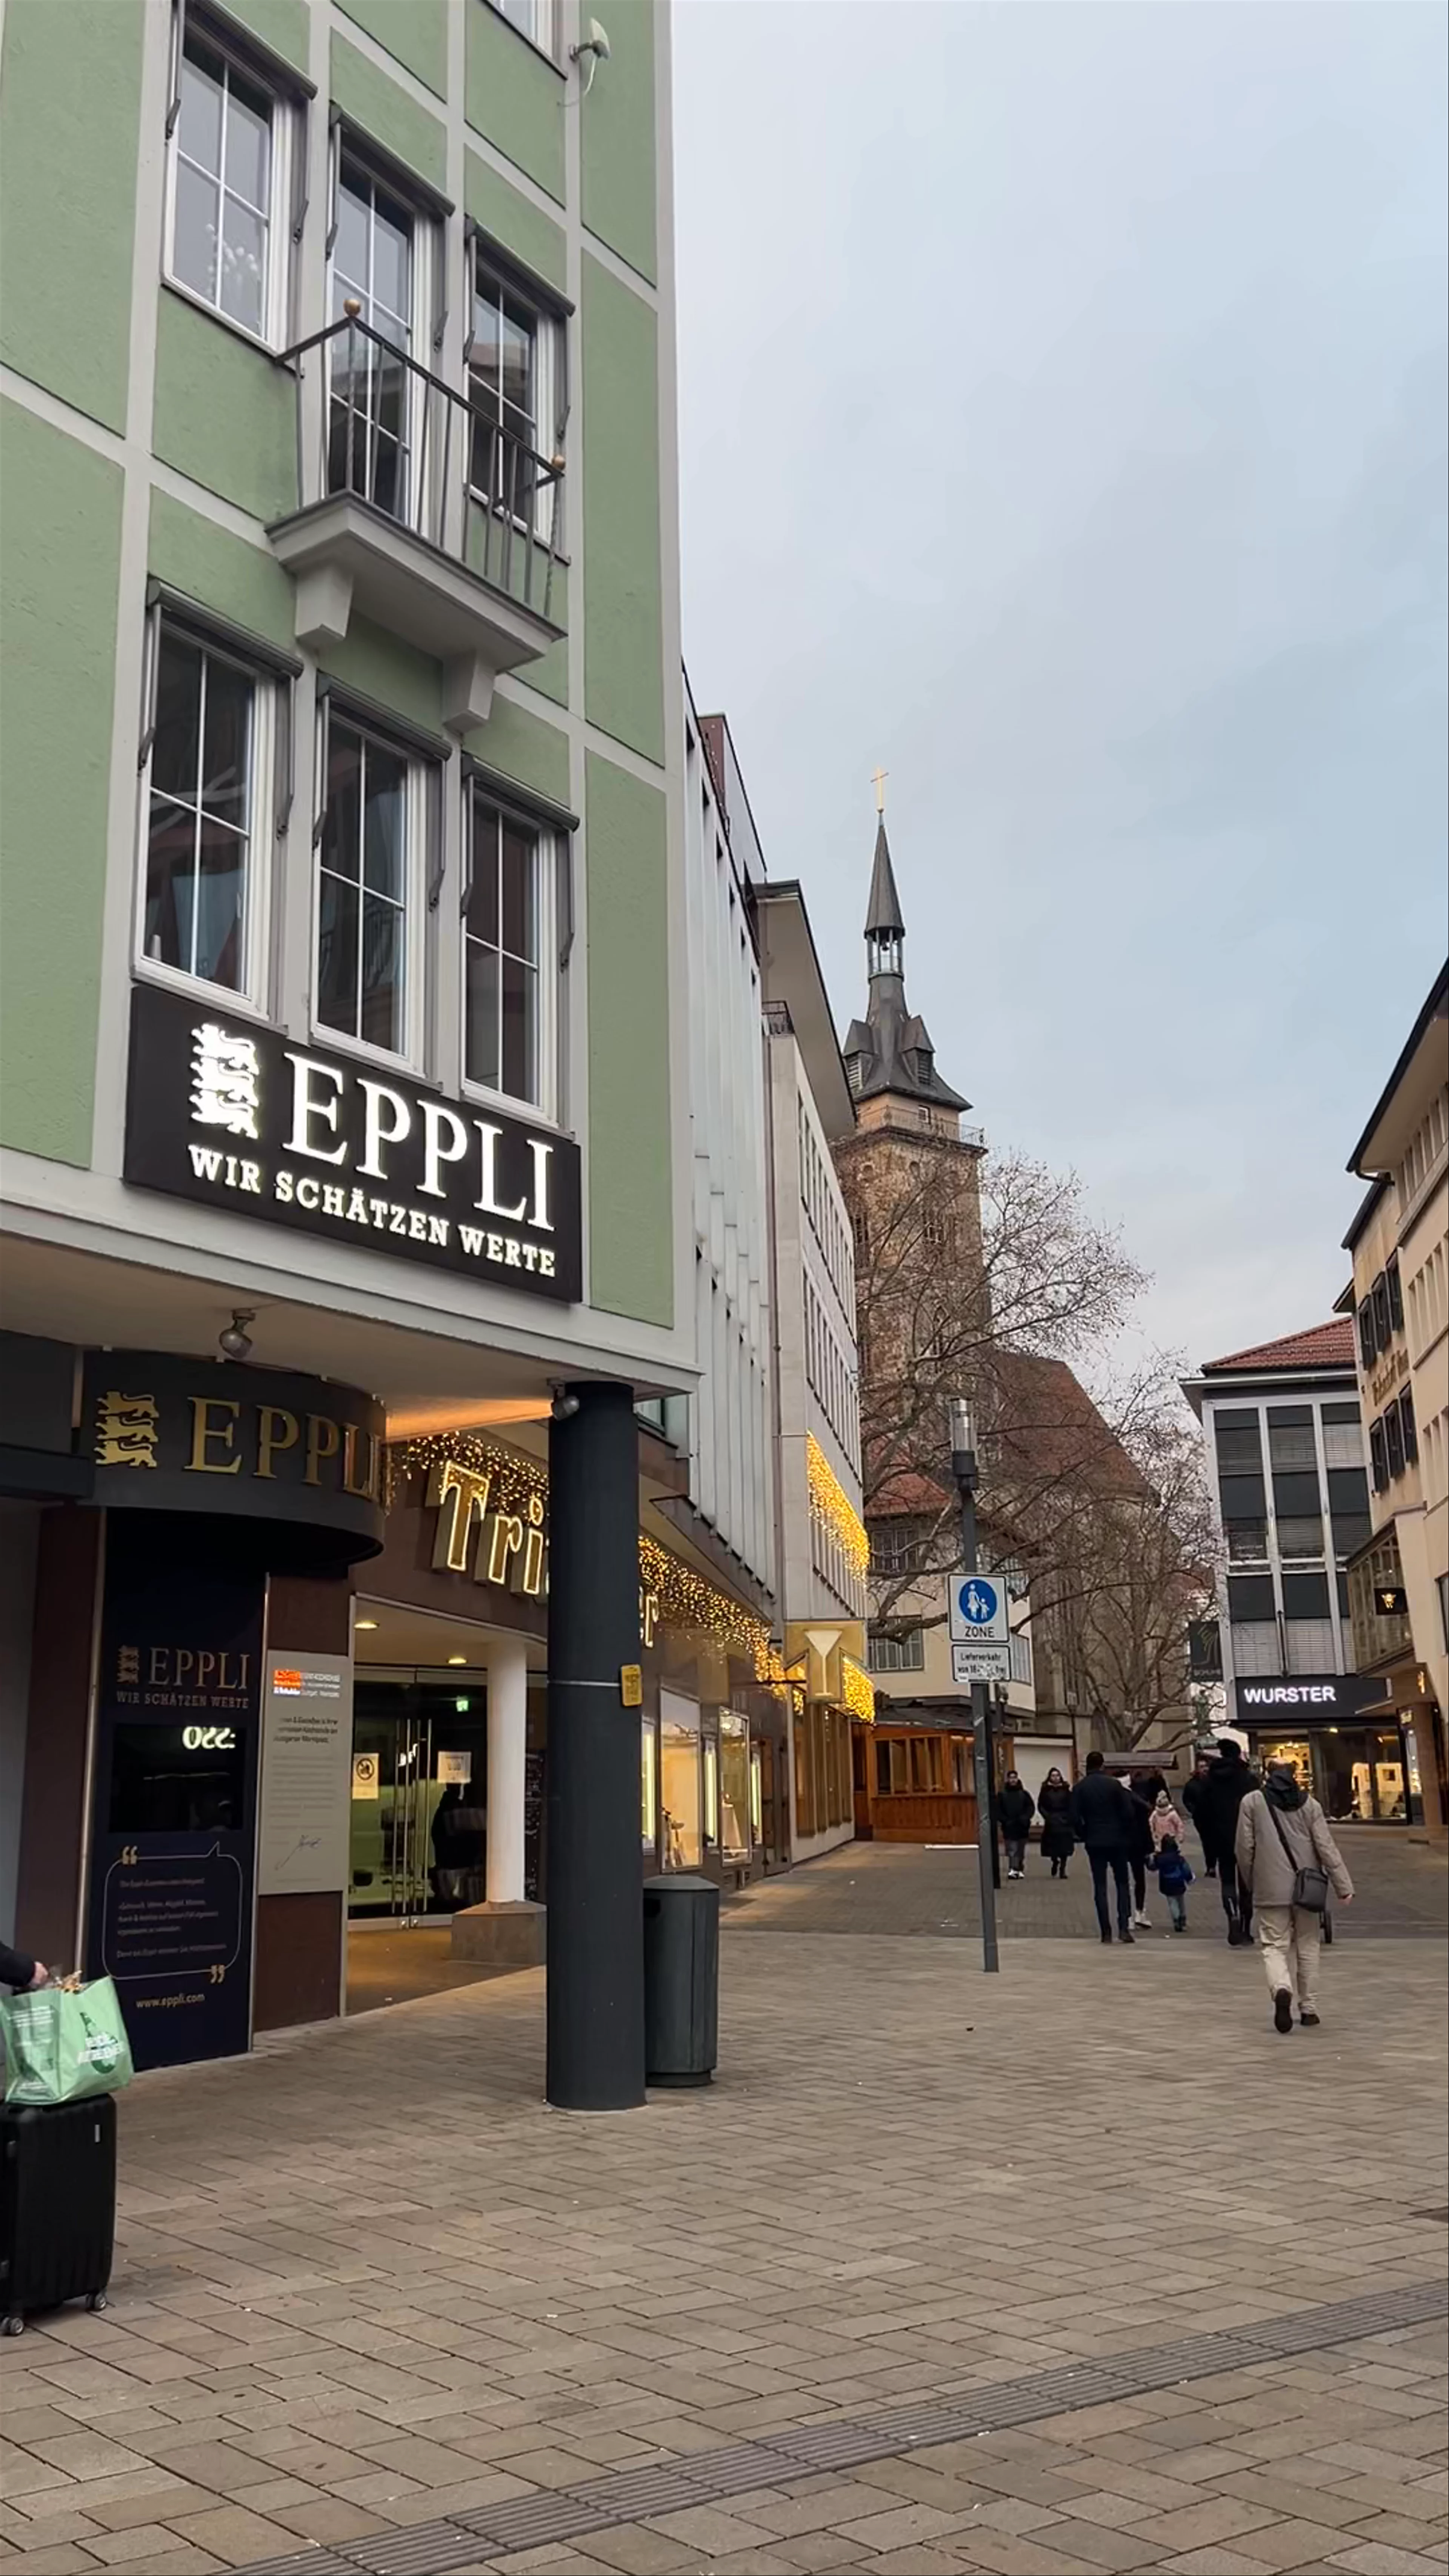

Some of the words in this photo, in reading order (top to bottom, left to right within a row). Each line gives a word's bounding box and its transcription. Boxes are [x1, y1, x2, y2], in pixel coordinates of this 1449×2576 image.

[282, 1052, 555, 1231] EPPLI
[188, 1144, 261, 1193] WIR
[274, 1172, 449, 1246] SCHÄTZEN
[459, 1224, 555, 1277] WERTE
[183, 1396, 381, 1501] EPPLI
[965, 1626, 995, 1638] ZONE
[149, 1647, 250, 1689] EPPLI
[116, 1691, 139, 1704] WIR
[211, 1696, 249, 1709] WERTE
[1244, 1686, 1337, 1704] WURSTER
[136, 1993, 206, 2009] www.eppli.com
